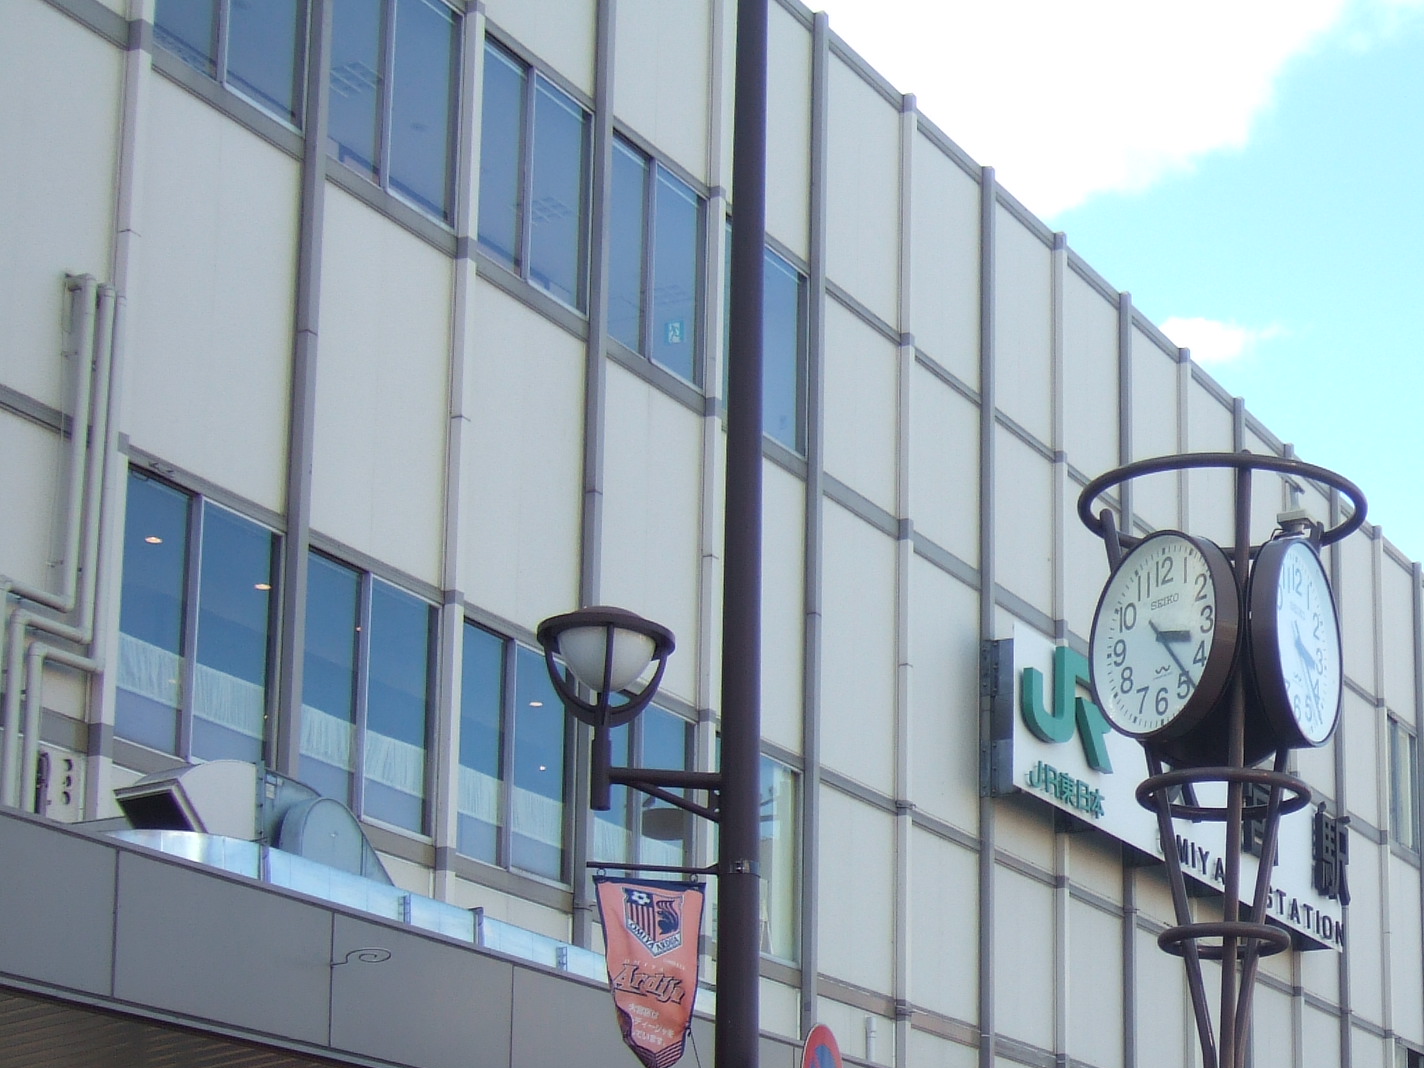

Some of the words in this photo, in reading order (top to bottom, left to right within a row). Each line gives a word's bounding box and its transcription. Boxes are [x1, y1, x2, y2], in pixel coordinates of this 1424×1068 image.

[1155, 555, 1174, 587] 12
[1183, 555, 1188, 584] 1
[1137, 570, 1151, 601] 11
[1194, 572, 1208, 602] 2
[1150, 593, 1180, 611] SEIKO
[1118, 602, 1138, 633] 10
[1200, 605, 1214, 633] 3
[1113, 639, 1127, 667] 9
[1192, 641, 1207, 668] 4
[1120, 666, 1134, 694] 8
[1176, 671, 1192, 699] 5
[1136, 686, 1150, 714] 7
[1155, 687, 1169, 716] 6
[1029, 760, 1106, 820] JR東日本
[1156, 828, 1227, 886] MIYA
